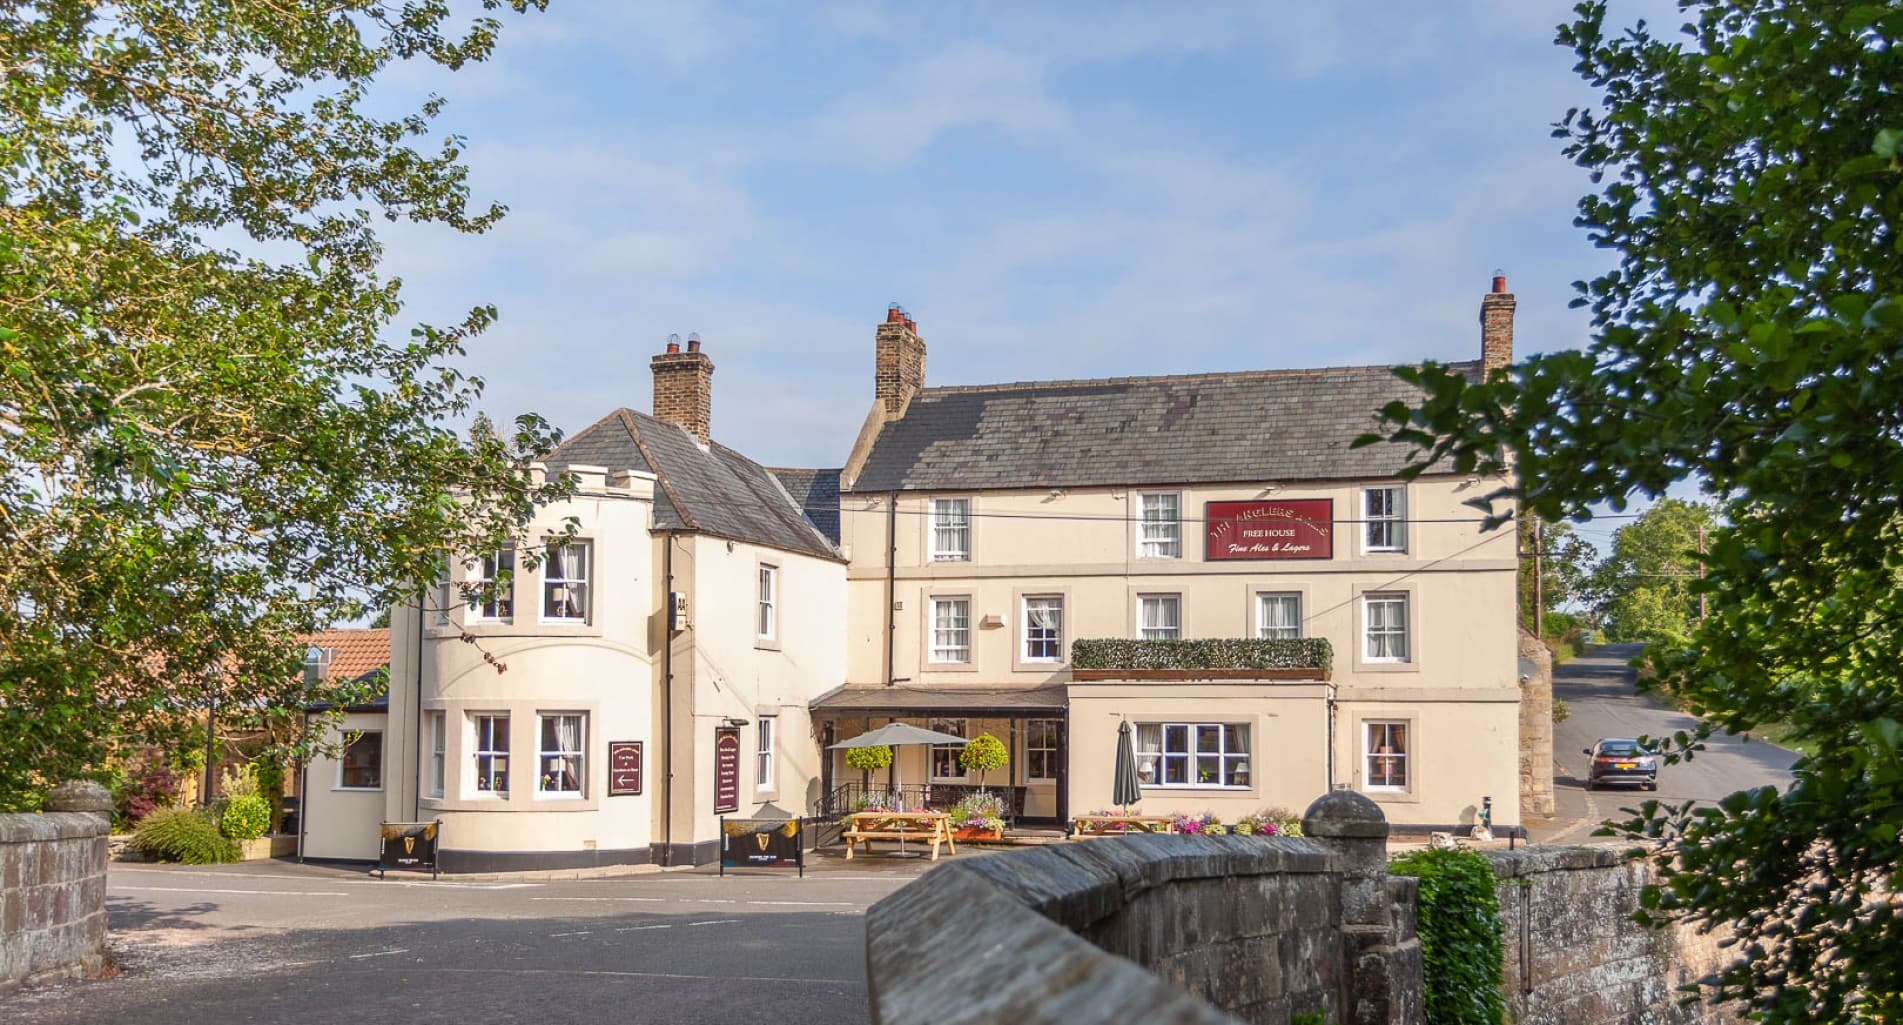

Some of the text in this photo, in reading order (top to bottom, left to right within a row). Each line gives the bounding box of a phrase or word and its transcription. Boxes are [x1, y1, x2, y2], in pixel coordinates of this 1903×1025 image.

[1243, 529, 1296, 537] FREE HOUSE
[1228, 542, 1311, 554] Fine Ales & Lagers
